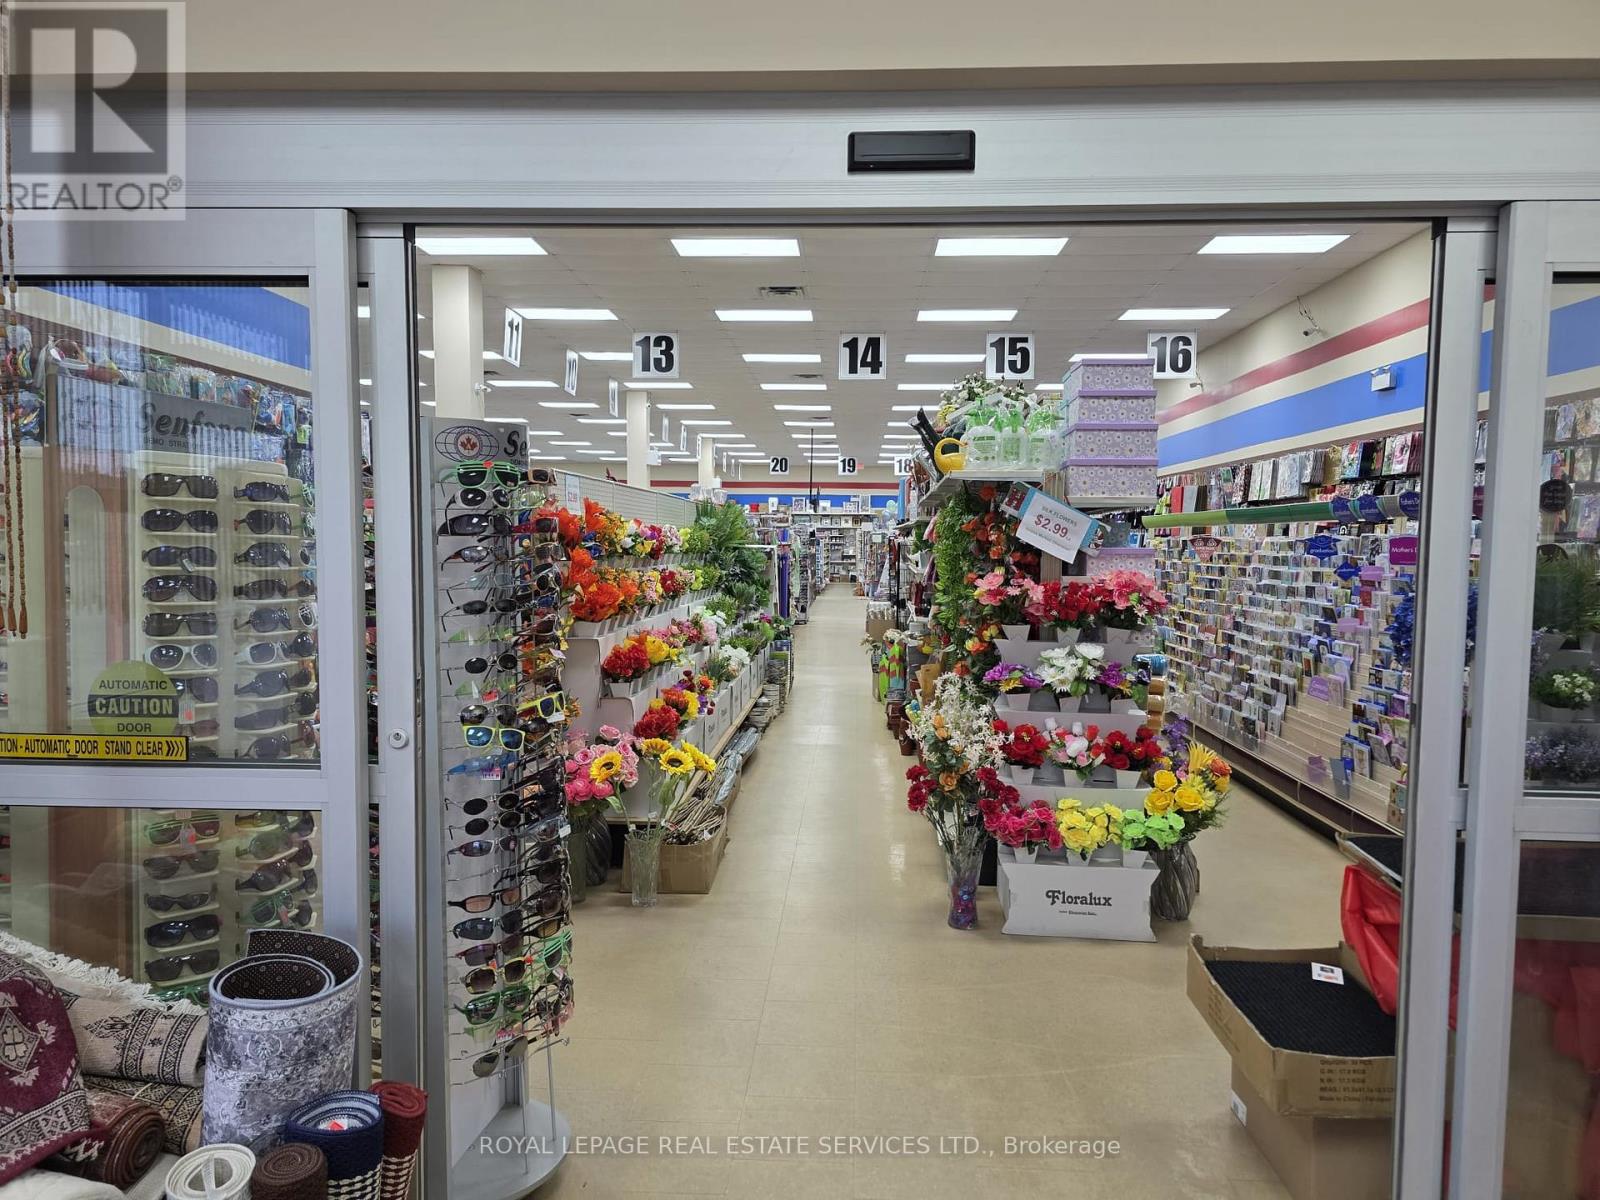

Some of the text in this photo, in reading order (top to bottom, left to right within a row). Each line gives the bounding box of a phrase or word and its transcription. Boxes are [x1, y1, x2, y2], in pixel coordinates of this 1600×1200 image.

[635, 335, 674, 373] 13
[842, 336, 883, 375] 14
[989, 336, 1031, 374] 15
[1151, 335, 1193, 374] 16
[771, 457, 789, 473] 20
[840, 457, 856, 473] 19
[896, 457, 912, 473] 18
[1033, 513, 1070, 539] $2.99
[99, 679, 168, 690] AUTOMATIC
[95, 698, 173, 716] CAUTION
[117, 722, 152, 733] DOOR
[25, 739, 71, 754] AUTOMATIC
[75, 740, 99, 755] DOOR
[105, 740, 131, 755] STAND
[136, 741, 164, 756] CLEAR
[1045, 889, 1113, 907] Floralux
